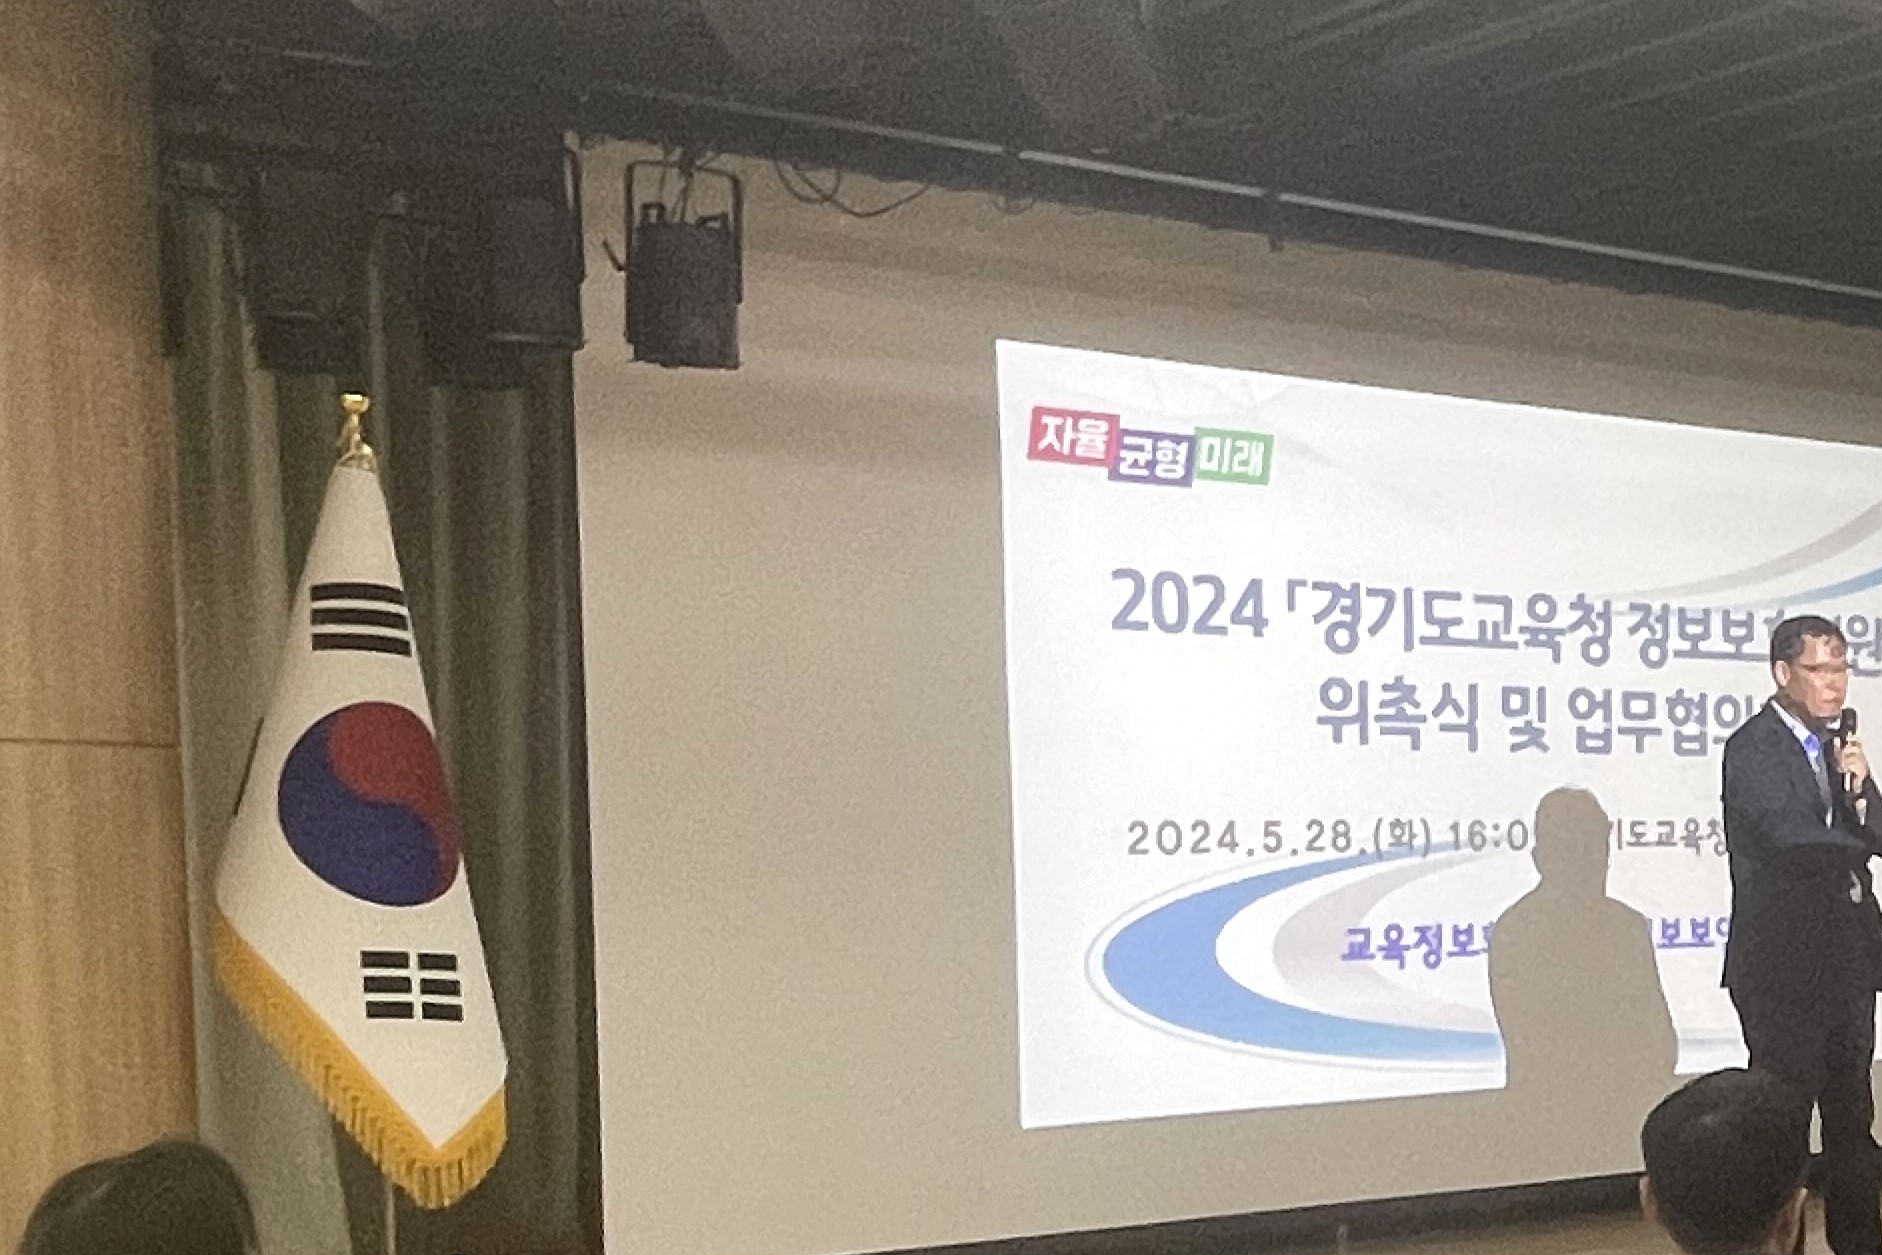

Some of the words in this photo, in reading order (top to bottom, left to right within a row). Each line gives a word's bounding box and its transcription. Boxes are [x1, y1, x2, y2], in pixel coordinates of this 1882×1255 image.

[1037, 414, 1110, 460] 자율
[1119, 435, 1189, 480] 균형
[1199, 436, 1265, 477] 미래
[1110, 567, 1269, 638] 2024
[1316, 675, 1479, 753] 위촉식
[1501, 685, 1551, 754] 및
[1568, 686, 1763, 758] 업무협의
[1449, 818, 1529, 852] 16:0
[1340, 921, 1493, 970] 교육정보
